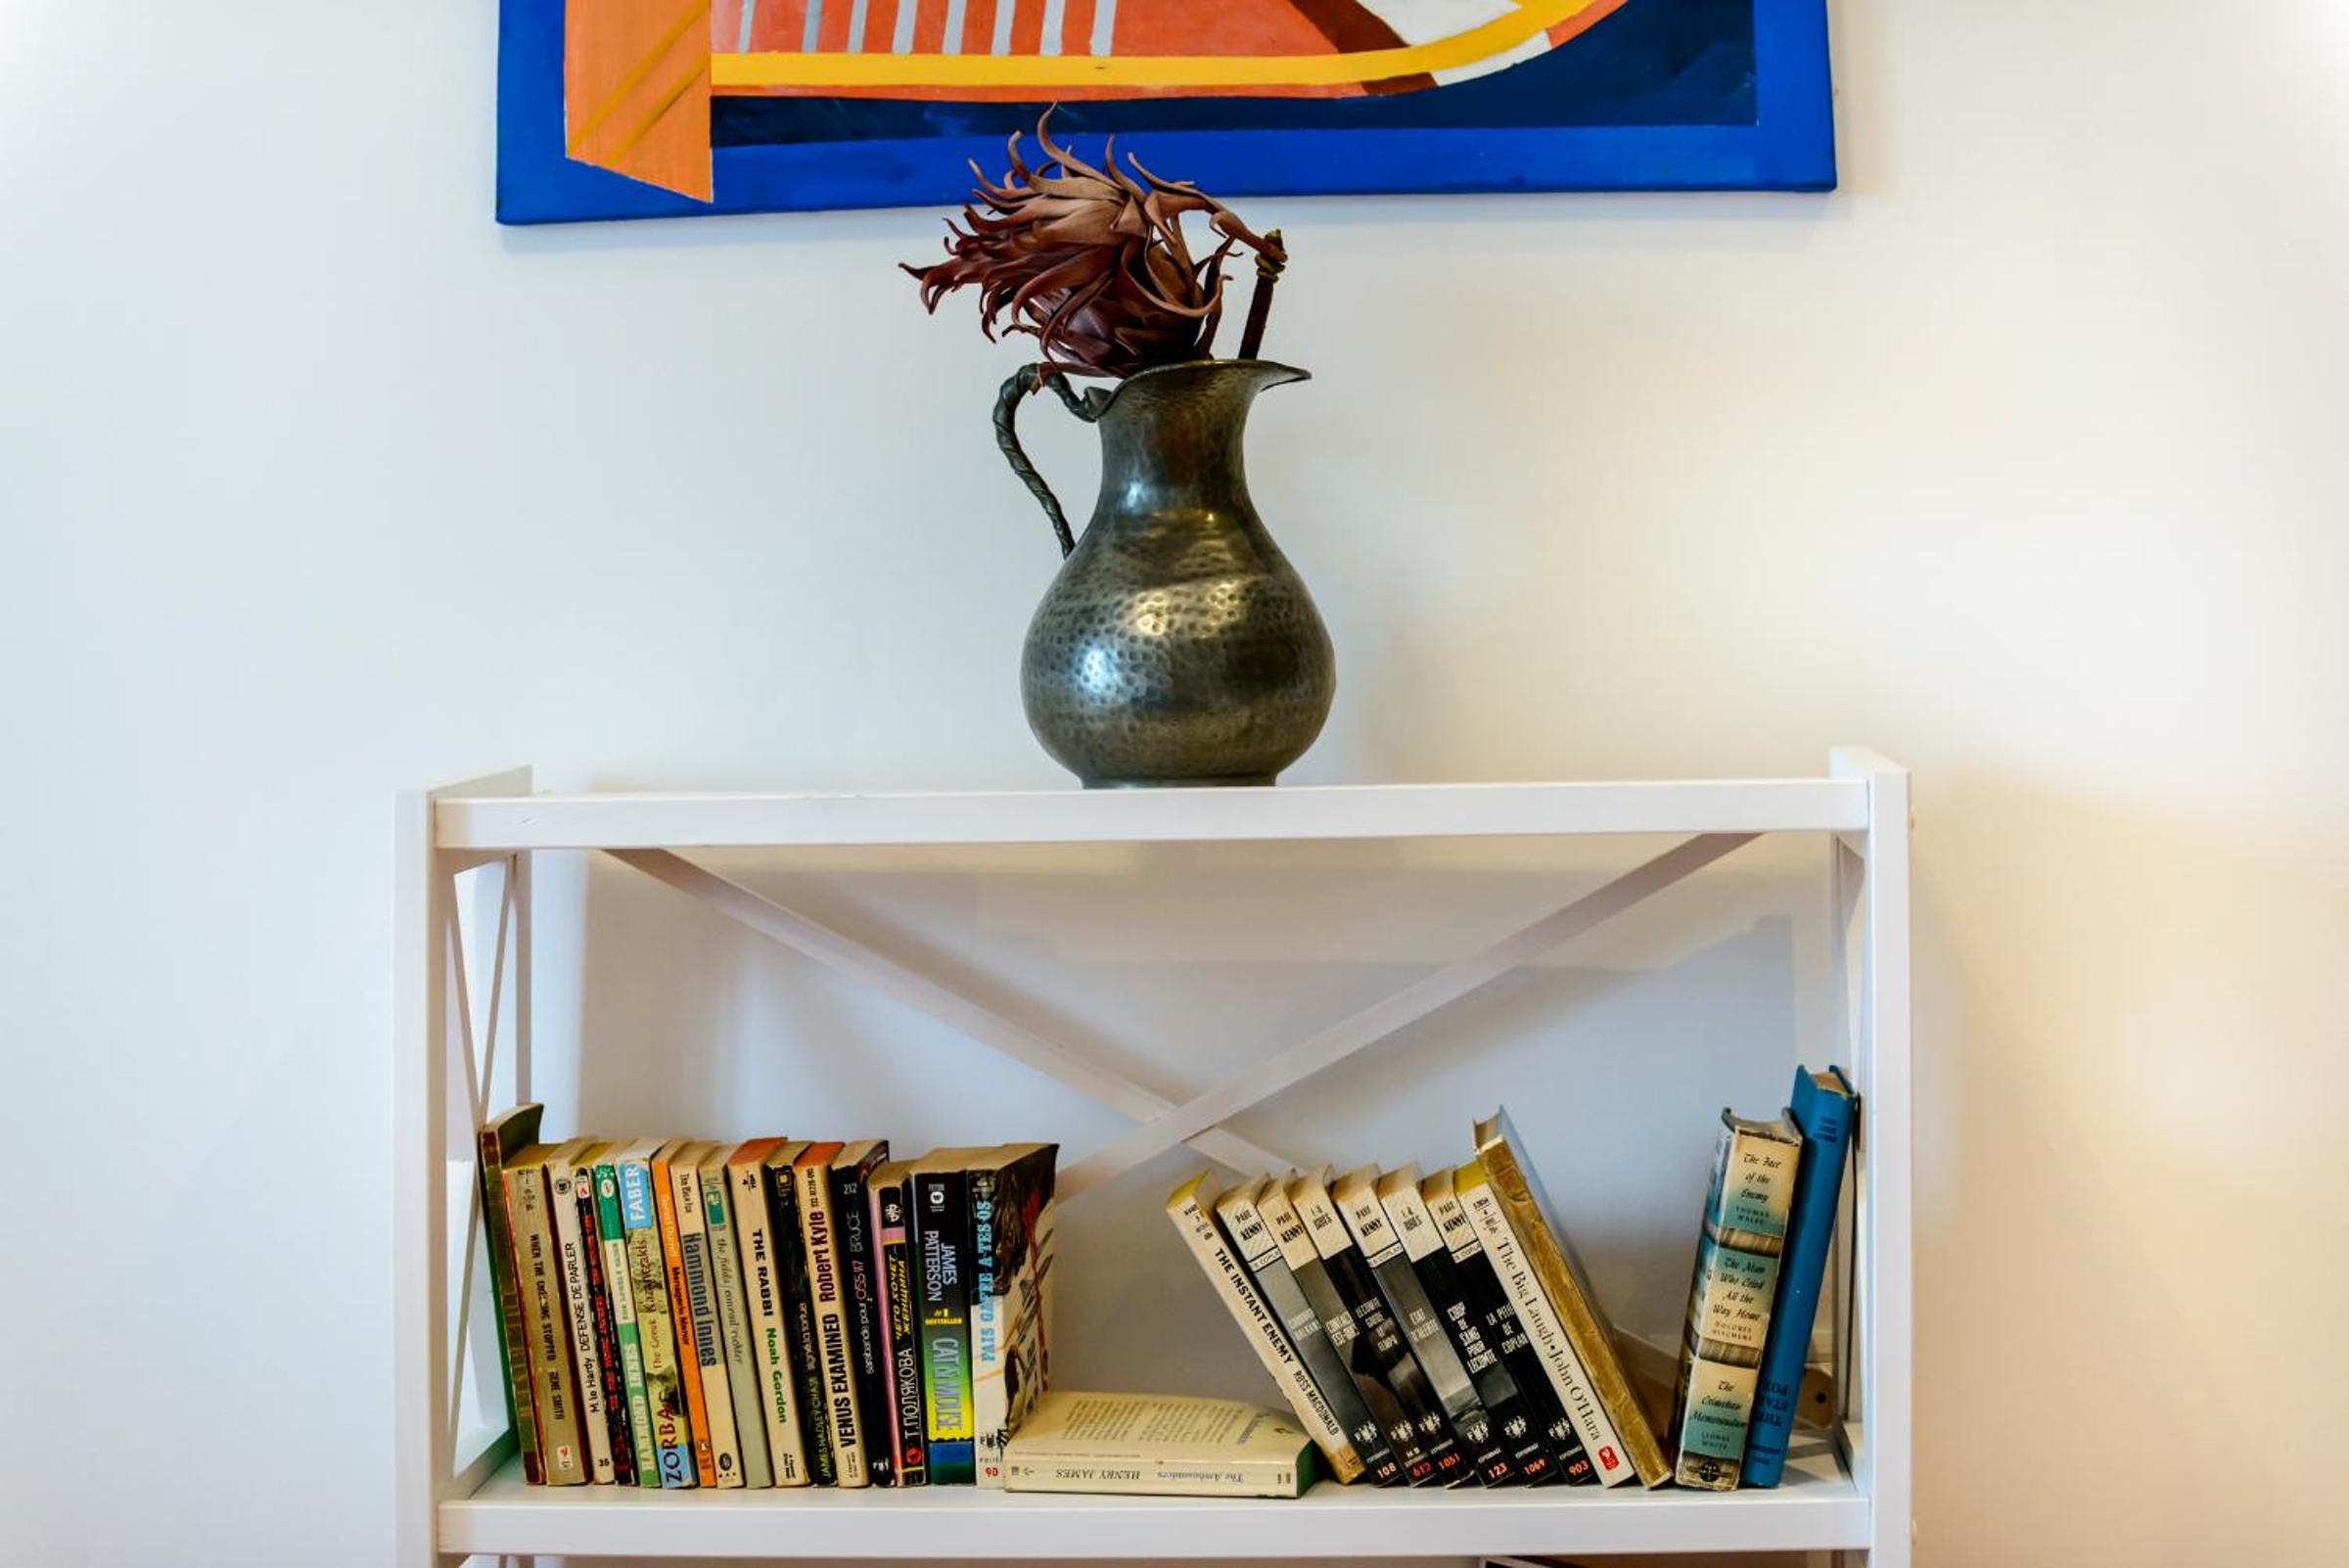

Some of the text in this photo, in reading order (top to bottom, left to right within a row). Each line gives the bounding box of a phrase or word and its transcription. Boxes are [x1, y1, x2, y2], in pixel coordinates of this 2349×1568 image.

[622, 1164, 645, 1222] FABER
[976, 1200, 991, 1219] OS
[1443, 1215, 1466, 1233] KENNY
[806, 1210, 828, 1245] Kyle
[846, 1210, 862, 1252] BRUCE
[976, 1222, 992, 1253] TES
[1240, 1222, 1263, 1241] KENNY
[1281, 1224, 1304, 1243] KENNY
[1360, 1218, 1382, 1237] KENNY
[533, 1260, 544, 1277] THE
[564, 1242, 579, 1283] PARLER
[812, 1248, 835, 1302] Robert
[924, 1230, 941, 1301] PATTERSON
[941, 1242, 956, 1285] JAMES
[572, 1284, 582, 1300] DE
[682, 1232, 719, 1366] Hammond Innes
[574, 1302, 590, 1352] DEFENSE
[752, 1228, 788, 1423] THE RABBI Noah Gordon
[1497, 1237, 1515, 1268] The
[1512, 1271, 1528, 1298] Big
[1525, 1298, 1554, 1344] Laugh
[1547, 1349, 1573, 1386] John
[1713, 1304, 1761, 1321] Way Home
[821, 1313, 849, 1394] EXAMINED
[932, 1337, 958, 1363] CAT
[1216, 1249, 1338, 1435] THE INSTANT ENEMY ROSS MACDONALD
[582, 1357, 598, 1388] Hardy
[1718, 1380, 1734, 1392] The
[834, 1396, 855, 1448] VENUS
[656, 1406, 681, 1483] ZORBA
[1056, 1468, 1139, 1479] HENRY JAMES
[1224, 1472, 1242, 1482] The
[1377, 1462, 1397, 1479] 108
[1488, 1462, 1508, 1479] 123
[1568, 1460, 1589, 1475] 903
